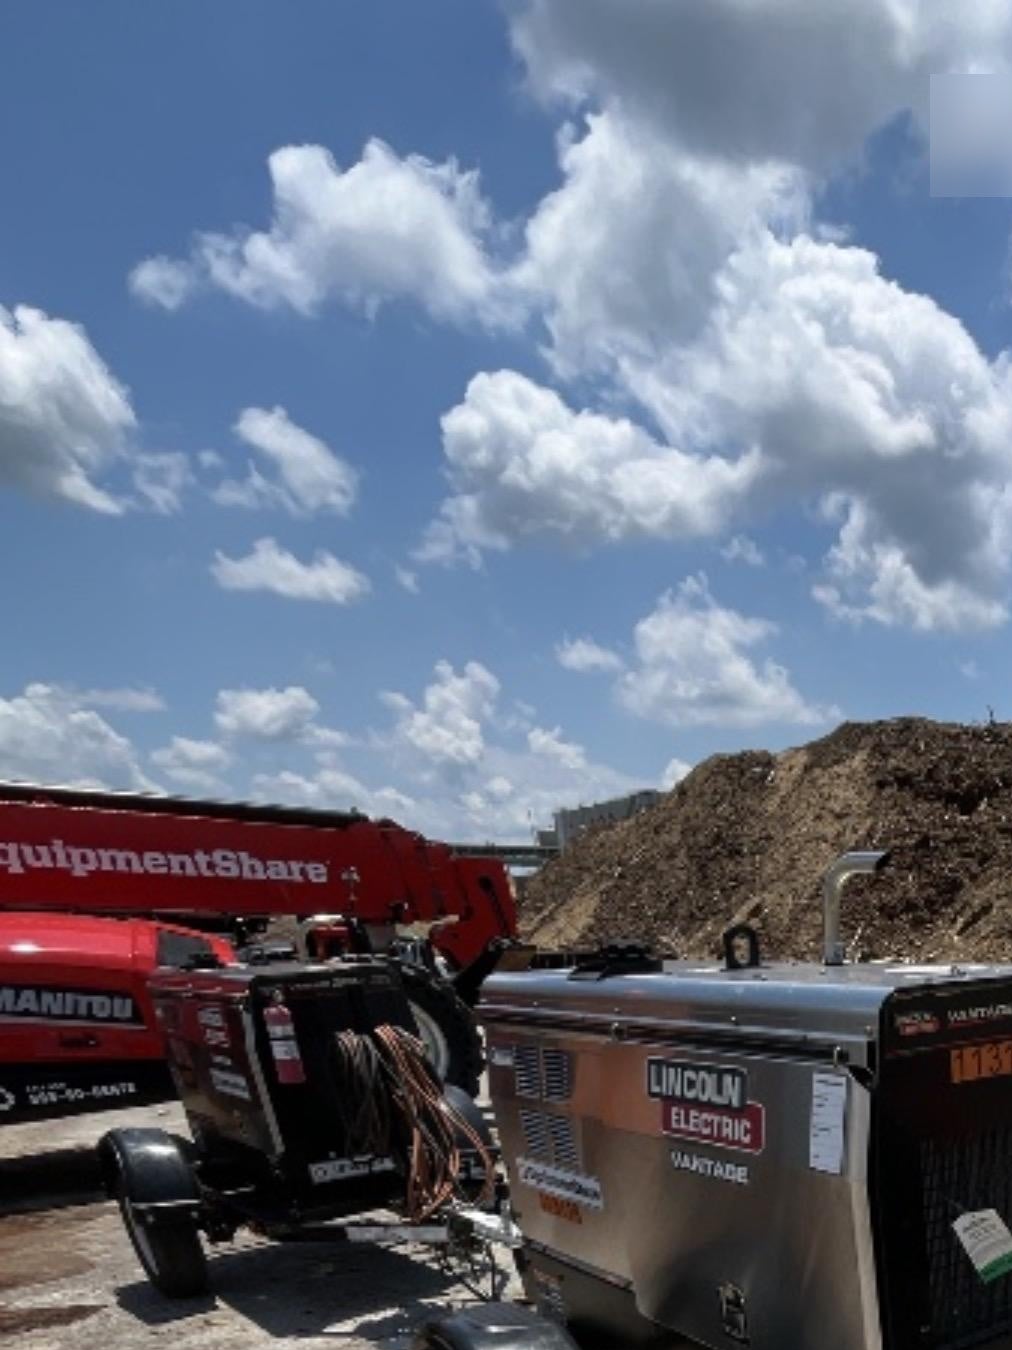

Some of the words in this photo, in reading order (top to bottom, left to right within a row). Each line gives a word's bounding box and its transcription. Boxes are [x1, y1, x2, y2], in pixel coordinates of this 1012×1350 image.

[0, 838, 328, 884] quipmentShare
[649, 1063, 741, 1108] LINCOLN
[670, 1106, 751, 1144] ELECTRIC
[670, 1151, 749, 1184] VANTAGE
